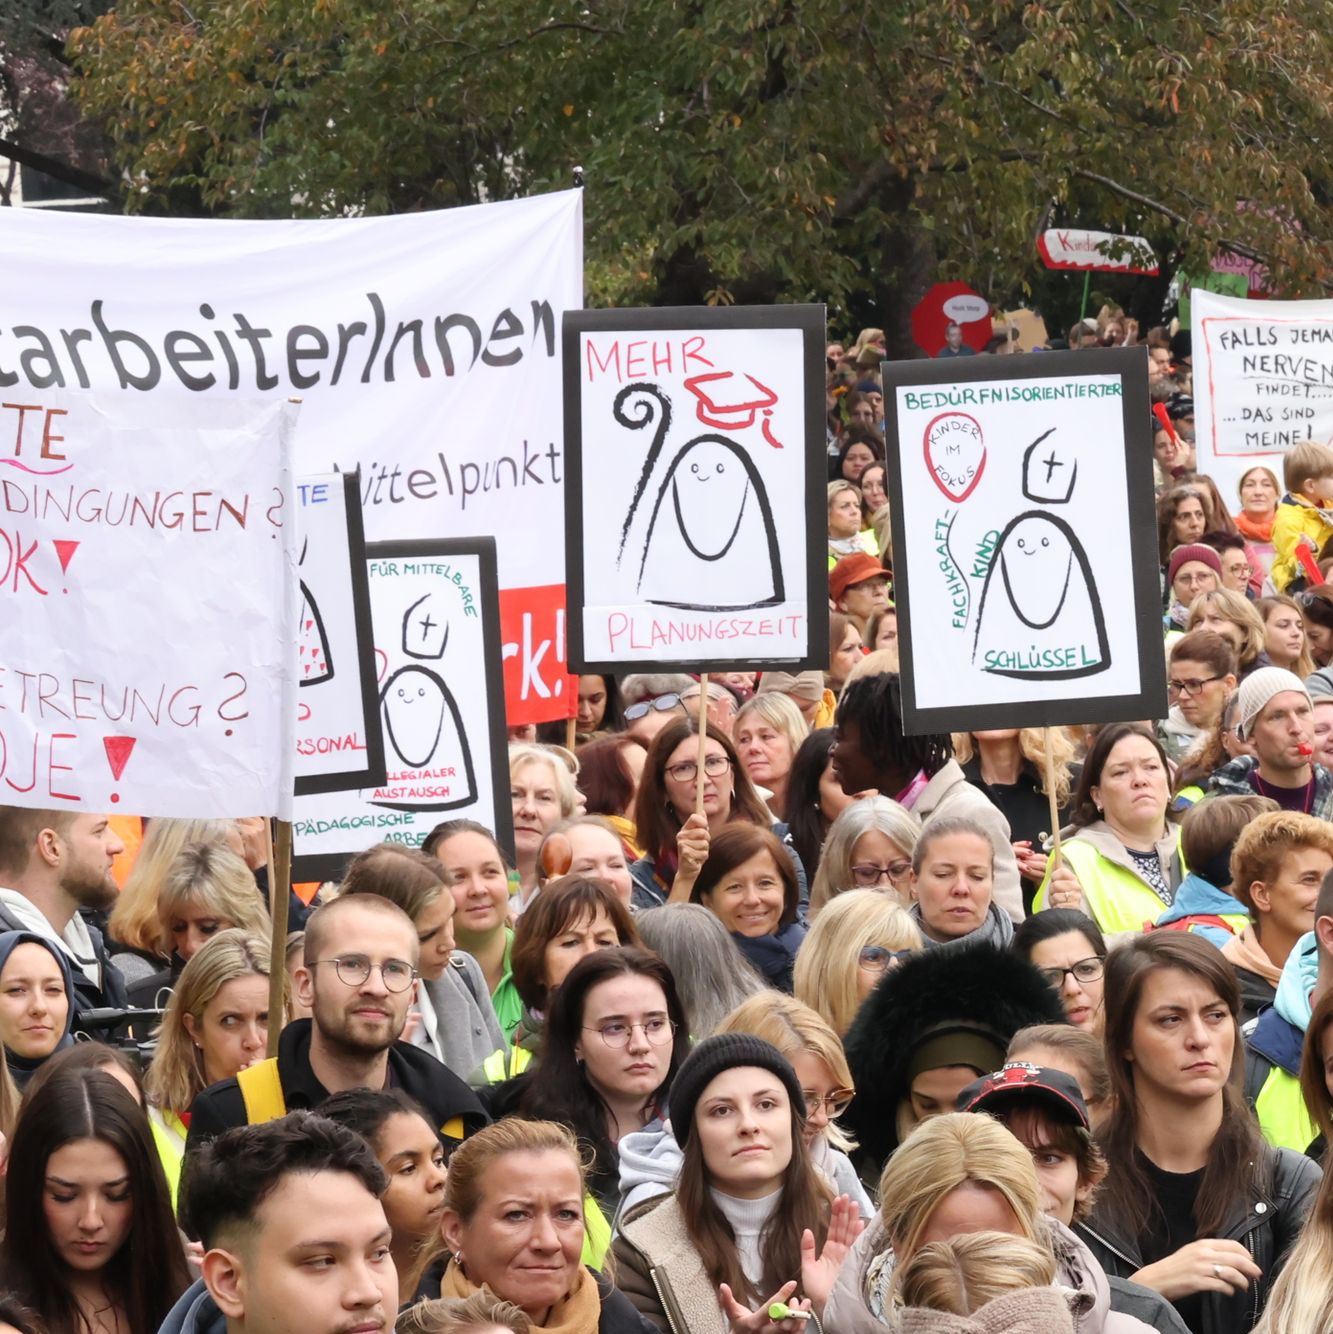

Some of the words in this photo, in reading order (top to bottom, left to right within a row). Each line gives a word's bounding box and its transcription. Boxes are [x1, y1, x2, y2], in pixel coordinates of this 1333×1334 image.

[1219, 326, 1278, 350] FALLS
[586, 336, 716, 384] MEHR
[905, 380, 1124, 411] BEDÜRFNISORIENTIERTER
[1281, 407, 1316, 421] SIND
[927, 419, 983, 447] KINDER
[1245, 423, 1313, 446] MEINE!
[944, 444, 961, 457] IM
[933, 464, 977, 489] FOKUS
[971, 529, 1001, 579] KIND
[370, 561, 399, 578] FÜR
[403, 561, 478, 618] MITTELBARE
[608, 612, 804, 654] PLANUNGSZEIT
[984, 645, 1102, 671] SCHLÜSSEL
[373, 785, 451, 799] AUSTAUSCH
[294, 812, 416, 837] PÄDAGOGISCHE
